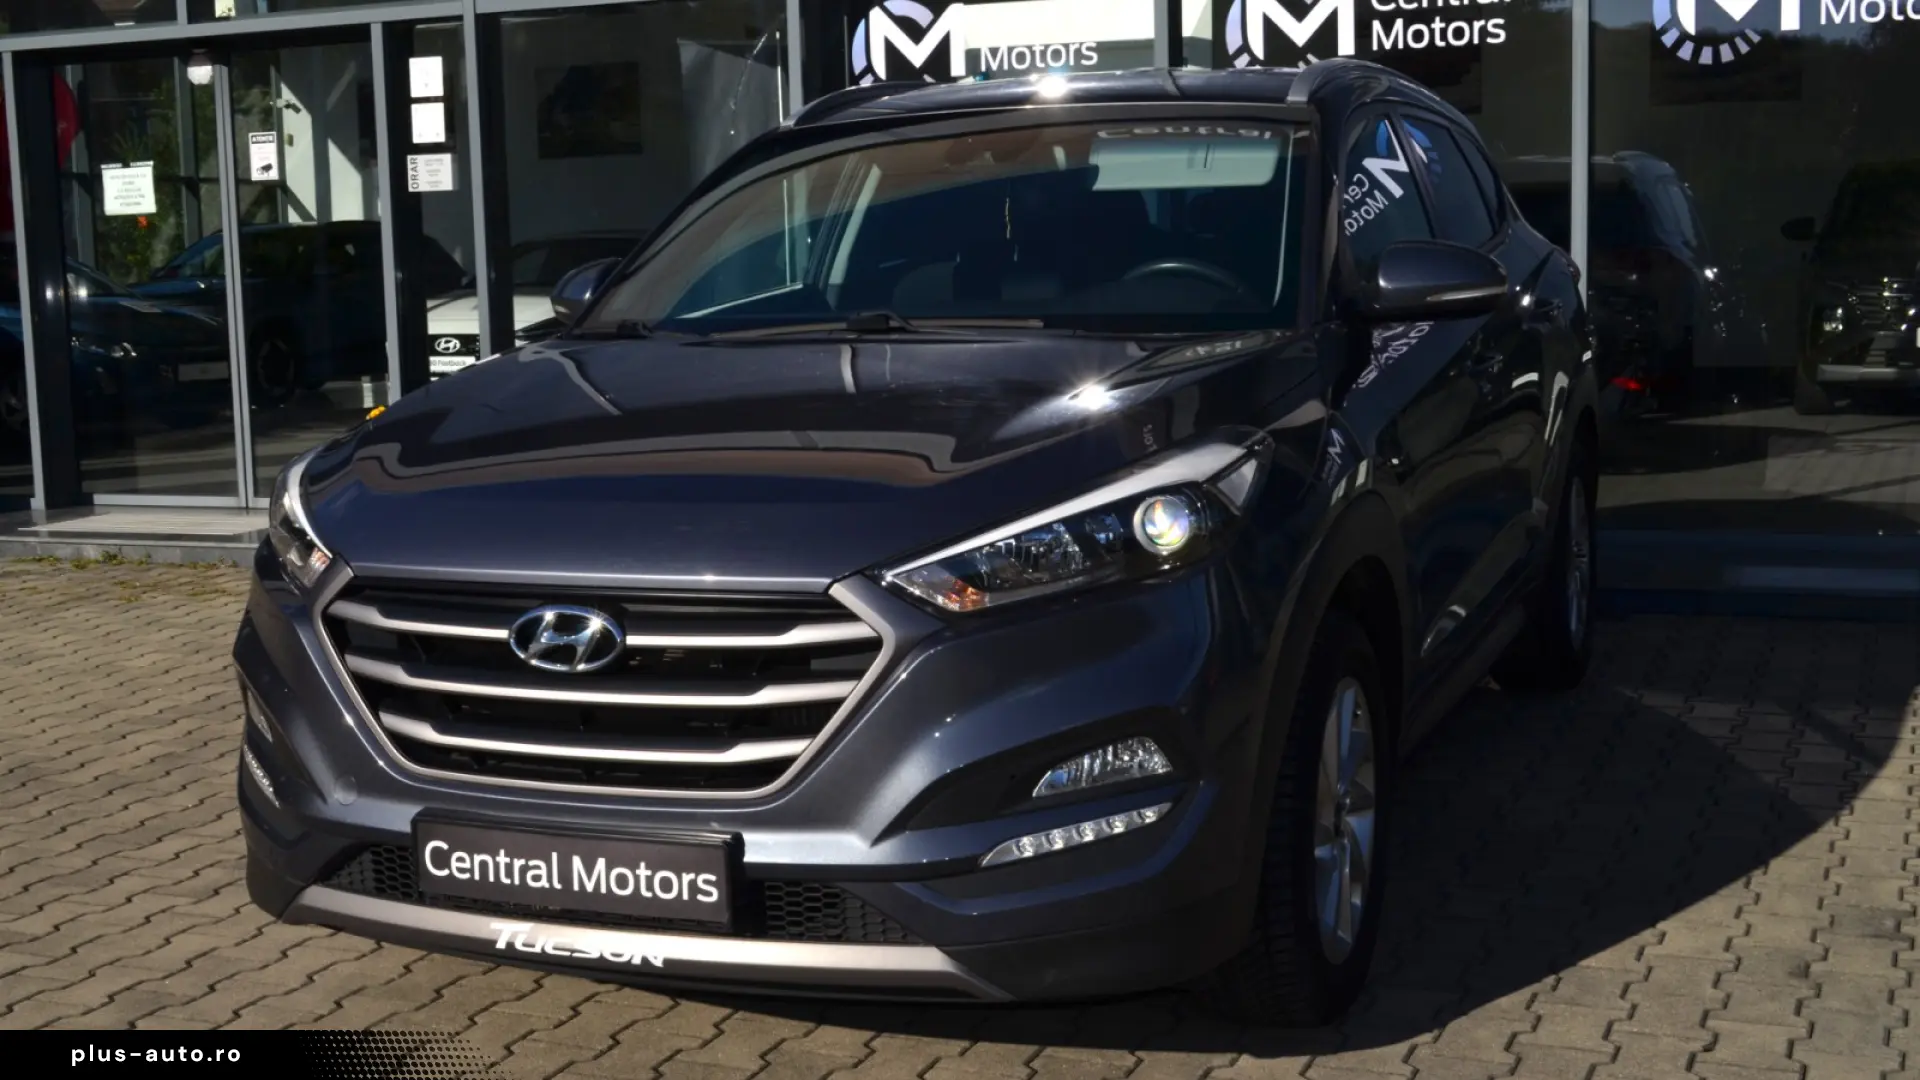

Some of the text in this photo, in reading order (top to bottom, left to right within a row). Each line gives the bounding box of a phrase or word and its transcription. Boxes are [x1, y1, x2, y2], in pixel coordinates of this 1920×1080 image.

[1371, 16, 1507, 51] Motors
[979, 41, 1099, 72] Motors
[409, 156, 421, 190] ORAR
[424, 840, 719, 903] Central Motors
